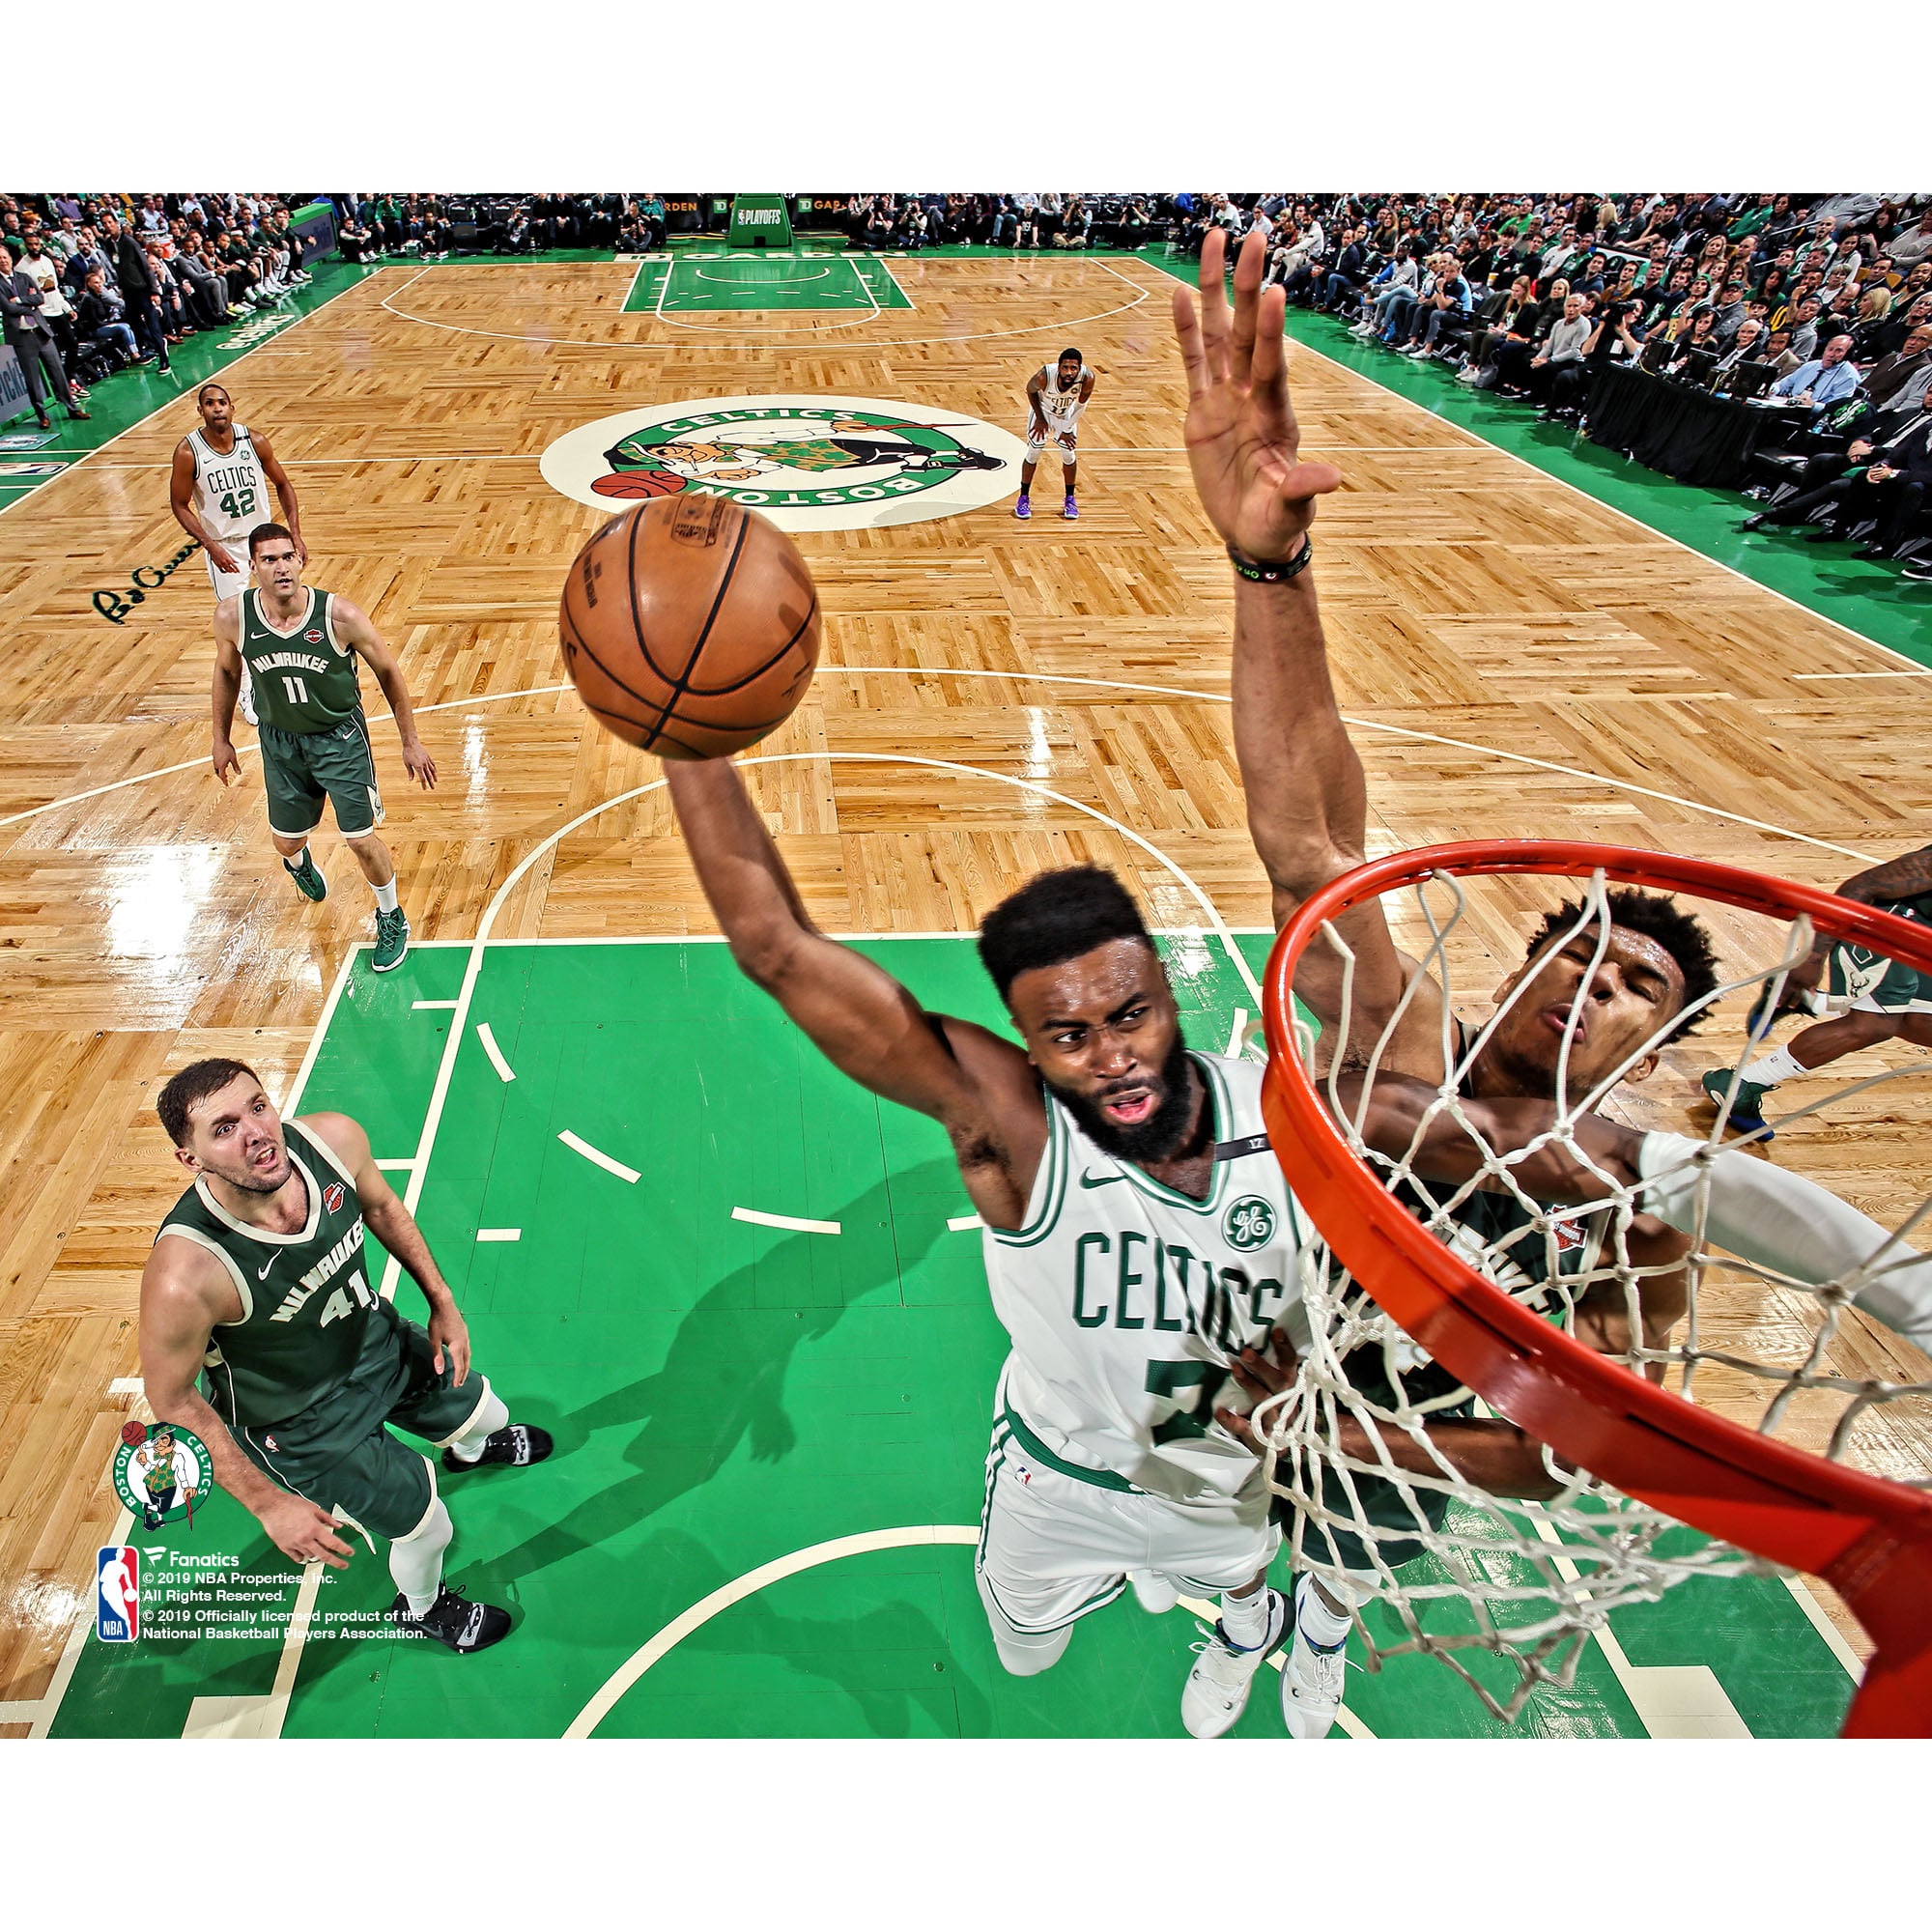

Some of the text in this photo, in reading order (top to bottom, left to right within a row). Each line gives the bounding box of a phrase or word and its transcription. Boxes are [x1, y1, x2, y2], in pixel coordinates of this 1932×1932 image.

[665, 202, 697, 212] RDEN
[714, 201, 726, 212] TD
[746, 209, 781, 225] PLAYOFFS
[799, 200, 811, 211] TD
[682, 251, 908, 260] GARDEN
[660, 408, 857, 433] CELTICS
[207, 466, 257, 495] CELTICS
[687, 477, 925, 507] BOSTON
[219, 488, 256, 519] 42
[251, 651, 330, 675] MILWAUKEE
[282, 676, 310, 704] 11
[319, 1267, 373, 1329] 41
[1072, 1230, 1284, 1356] CELTICS
[1144, 1357, 1236, 1448] 7
